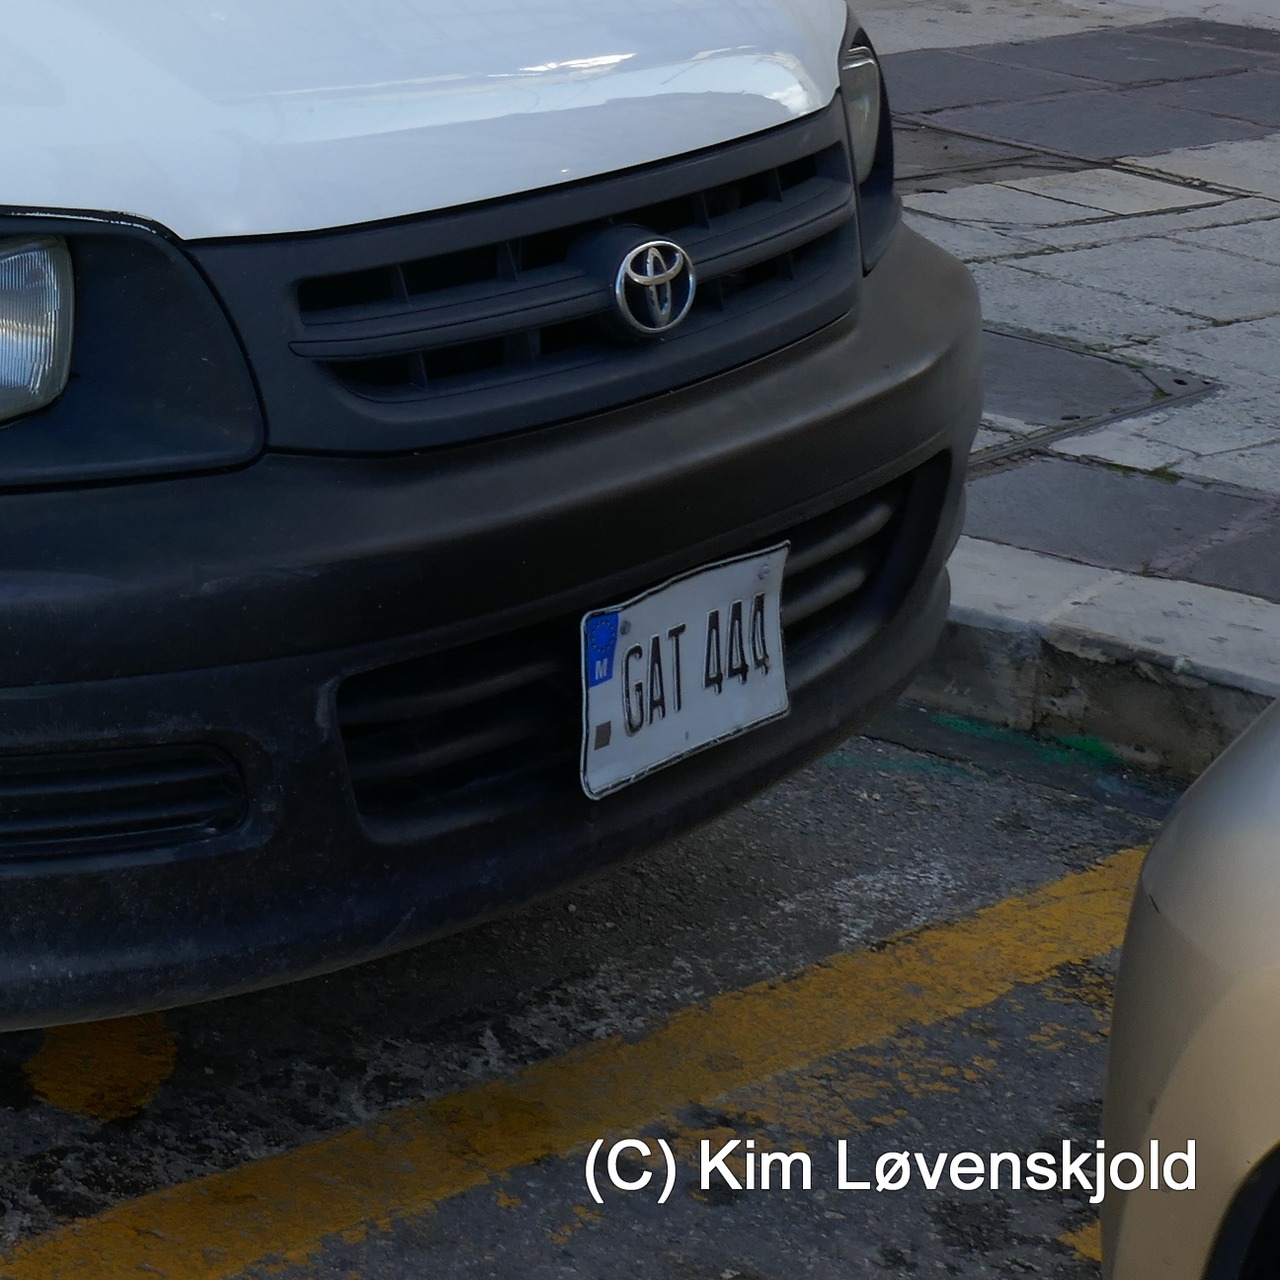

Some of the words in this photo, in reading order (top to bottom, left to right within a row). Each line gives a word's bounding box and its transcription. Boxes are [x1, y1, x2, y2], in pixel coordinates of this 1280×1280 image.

[595, 658, 608, 680] M
[621, 623, 686, 737] GAT
[703, 592, 770, 696] 444
